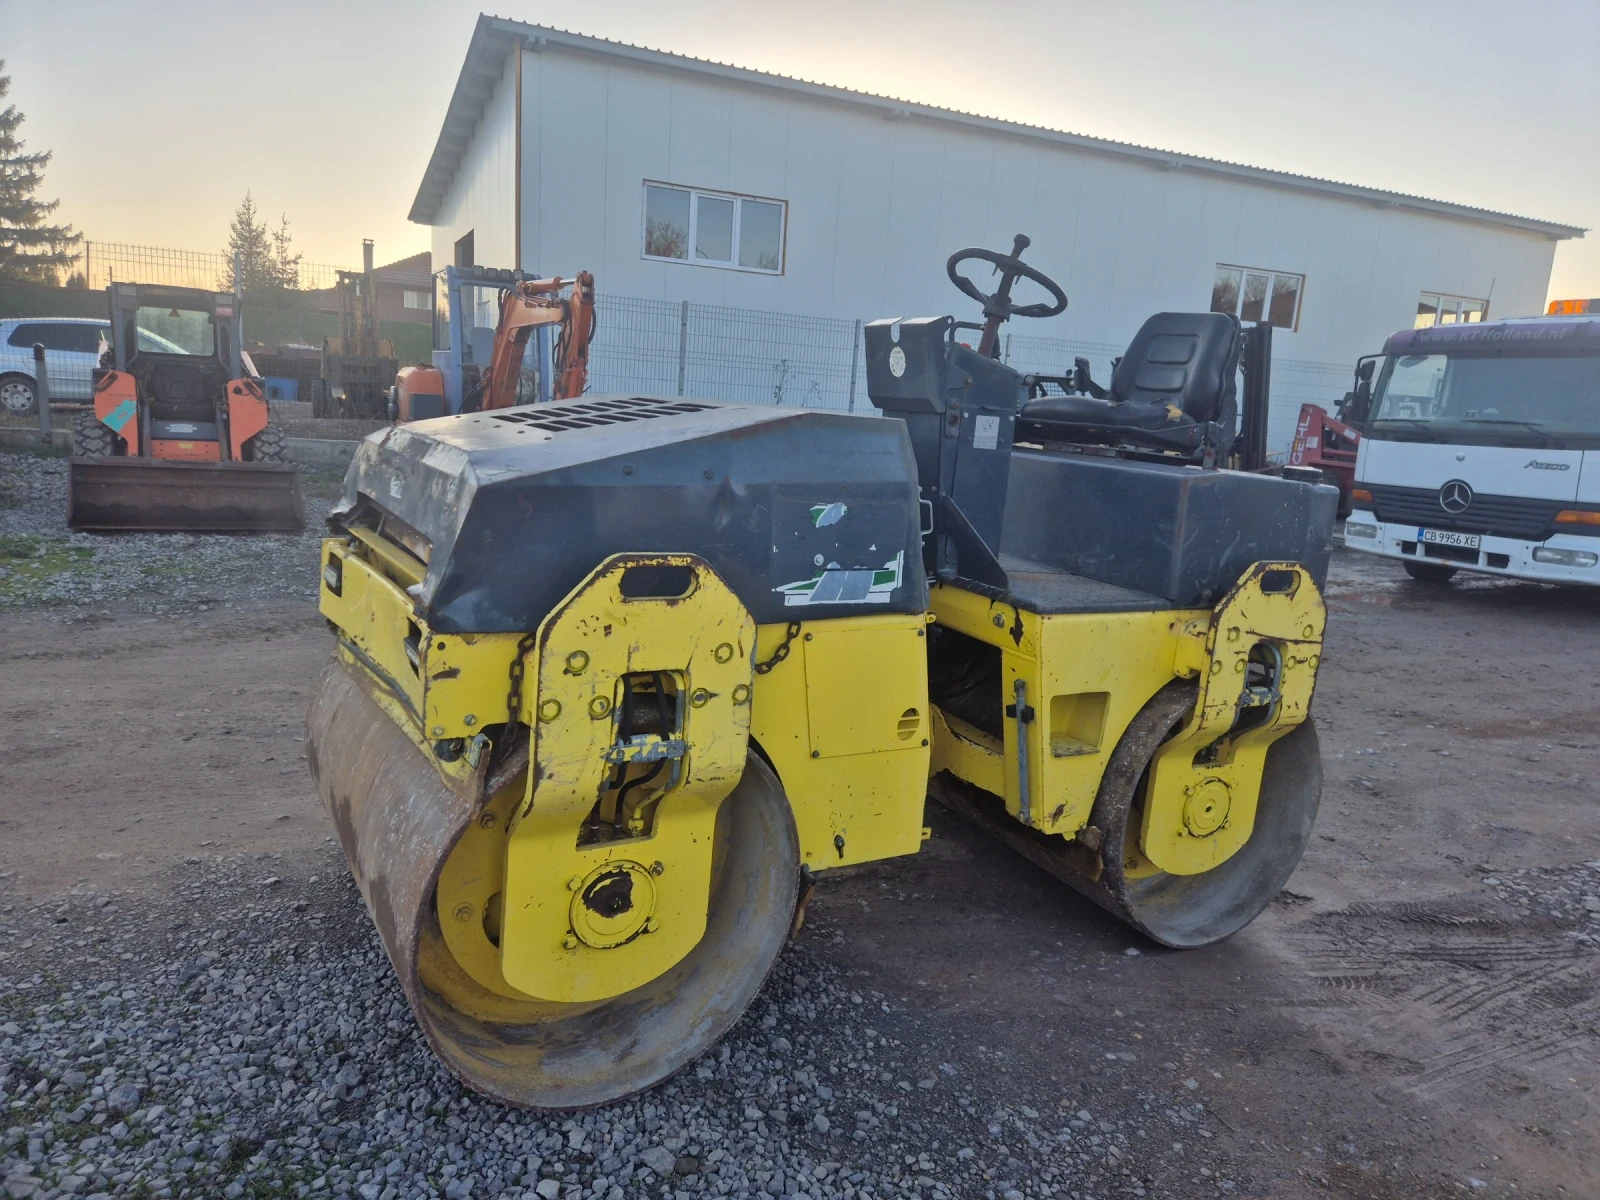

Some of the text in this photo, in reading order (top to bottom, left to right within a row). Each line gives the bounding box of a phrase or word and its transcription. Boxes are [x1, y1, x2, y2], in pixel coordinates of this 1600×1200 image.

[1292, 415, 1310, 465] GEHL
[1424, 531, 1477, 547] CB 9956 XE
